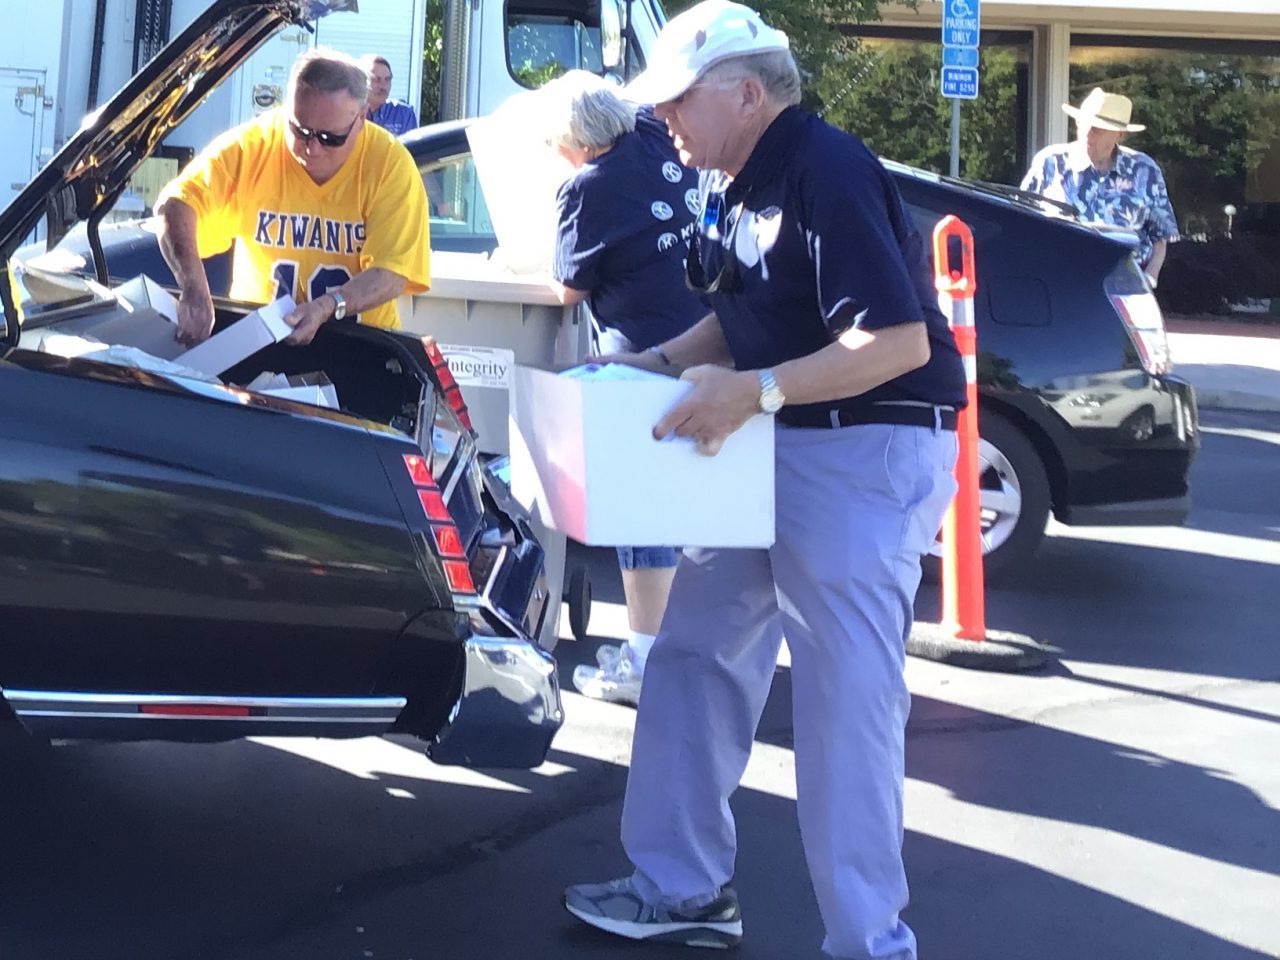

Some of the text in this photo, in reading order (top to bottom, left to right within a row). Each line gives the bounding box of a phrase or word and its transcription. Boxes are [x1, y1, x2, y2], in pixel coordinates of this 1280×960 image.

[946, 17, 977, 30] PARKING
[952, 31, 971, 43] ONLY
[945, 82, 956, 92] FINE
